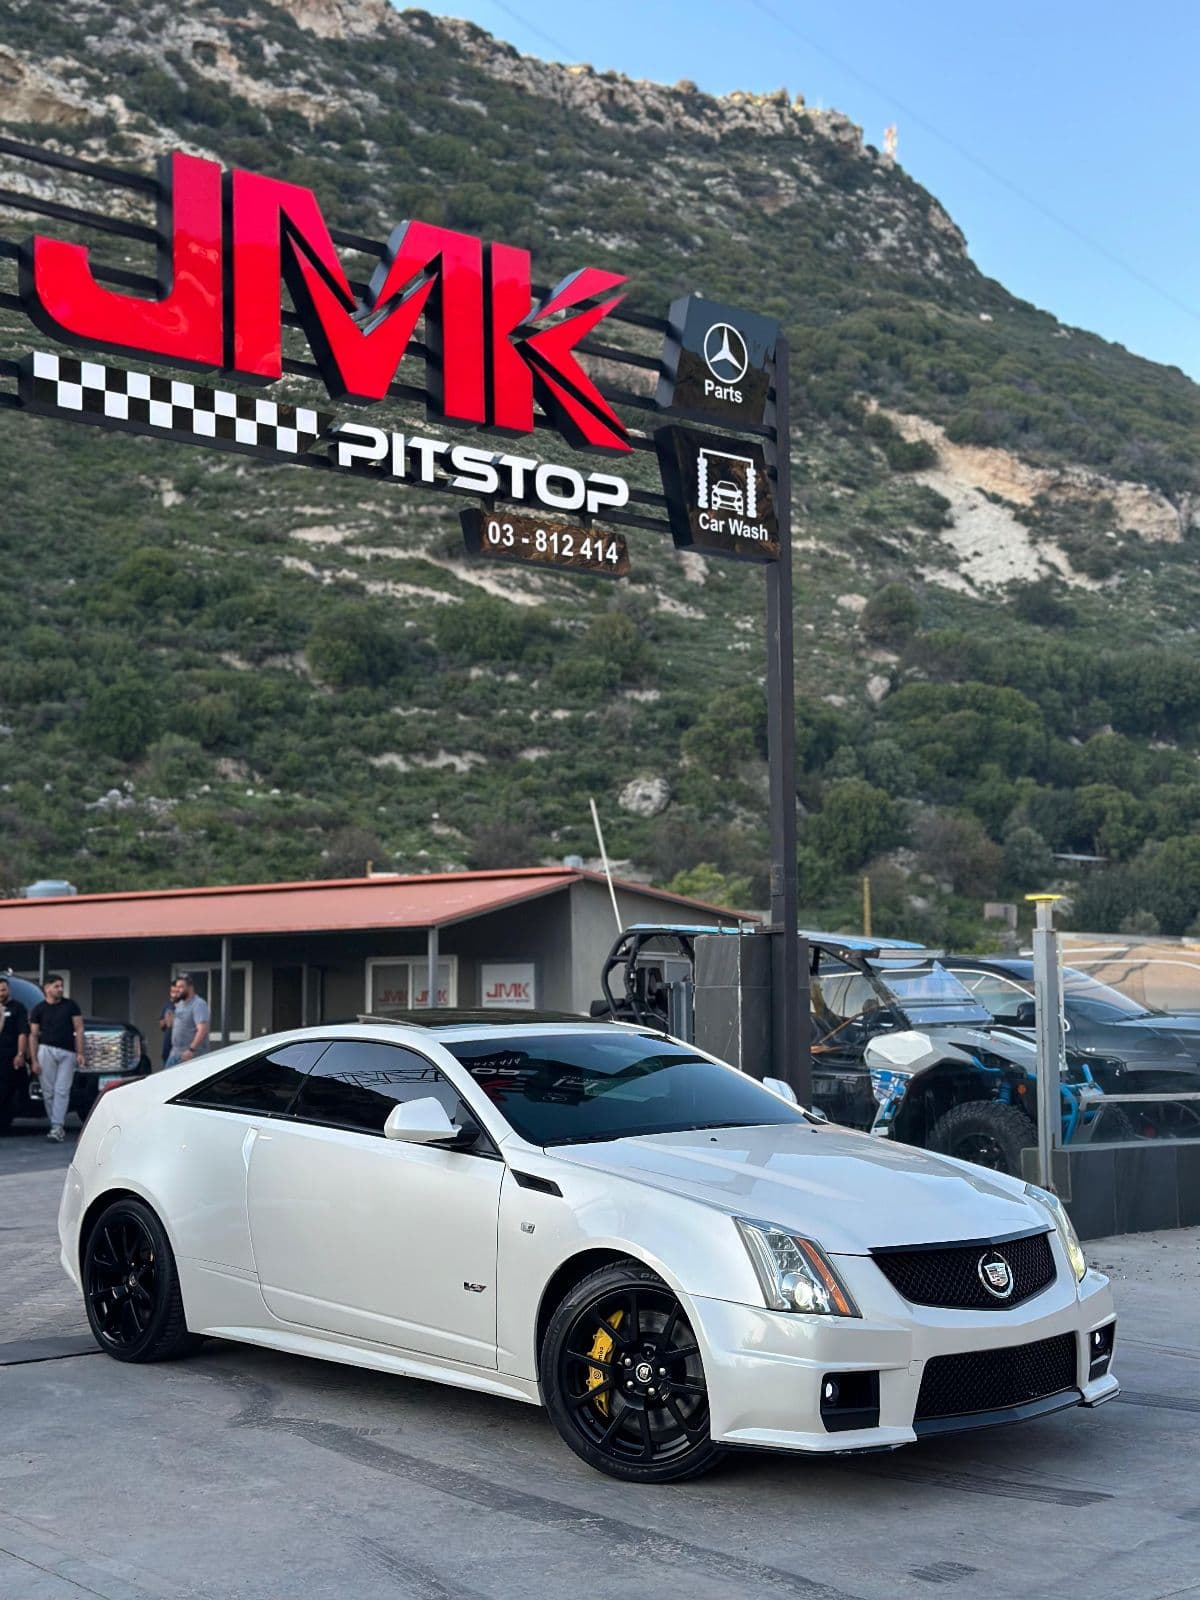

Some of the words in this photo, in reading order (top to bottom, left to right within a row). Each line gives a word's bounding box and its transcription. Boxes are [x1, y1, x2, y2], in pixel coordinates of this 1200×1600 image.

[34, 151, 634, 453] JMK
[704, 379, 743, 404] Parts
[337, 422, 630, 514] PITSTOP
[488, 521, 514, 547] 03
[535, 529, 574, 557] 812
[580, 537, 618, 564] 414
[698, 513, 725, 533] Car
[728, 518, 769, 541] Wash
[486, 982, 530, 998] JMK
